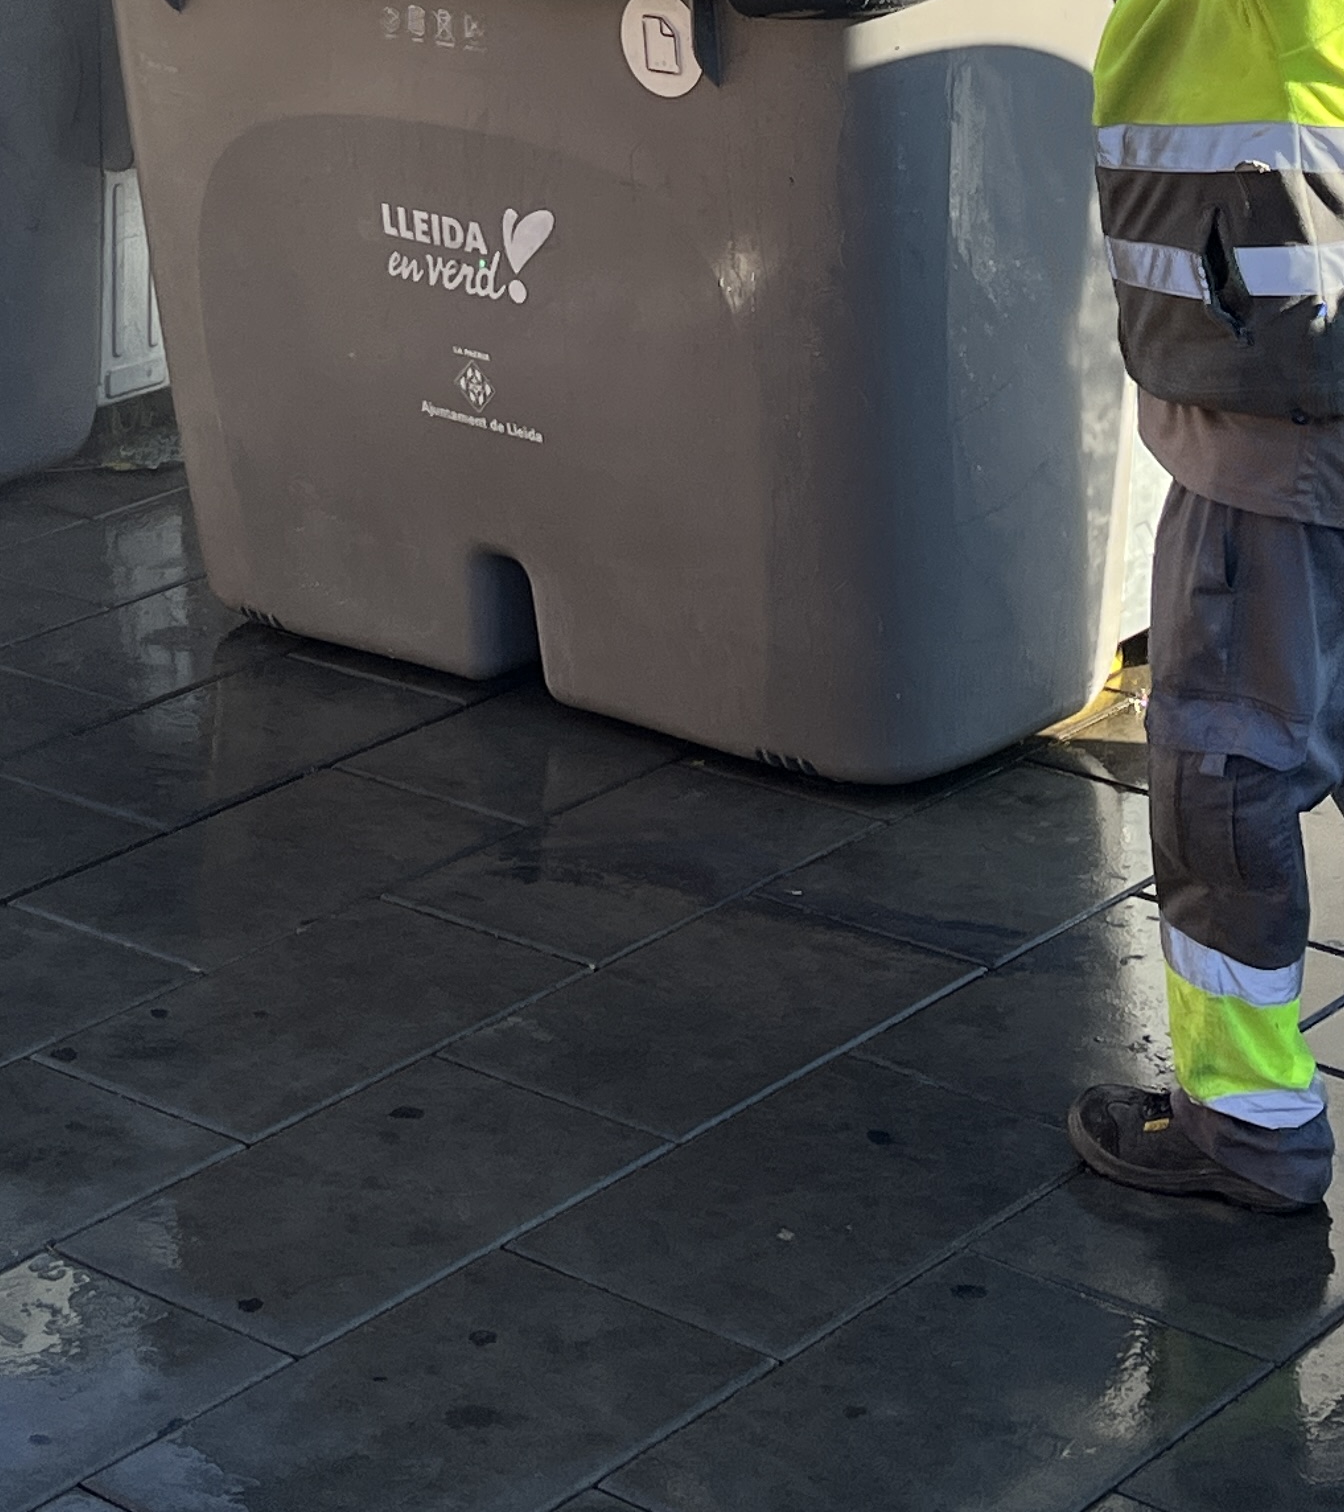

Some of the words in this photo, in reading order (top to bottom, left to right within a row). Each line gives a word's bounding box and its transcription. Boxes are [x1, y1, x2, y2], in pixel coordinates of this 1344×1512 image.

[381, 202, 488, 255] LLEIDA
[388, 250, 424, 283] en
[489, 419, 505, 433] de
[506, 422, 543, 443] Lleida
